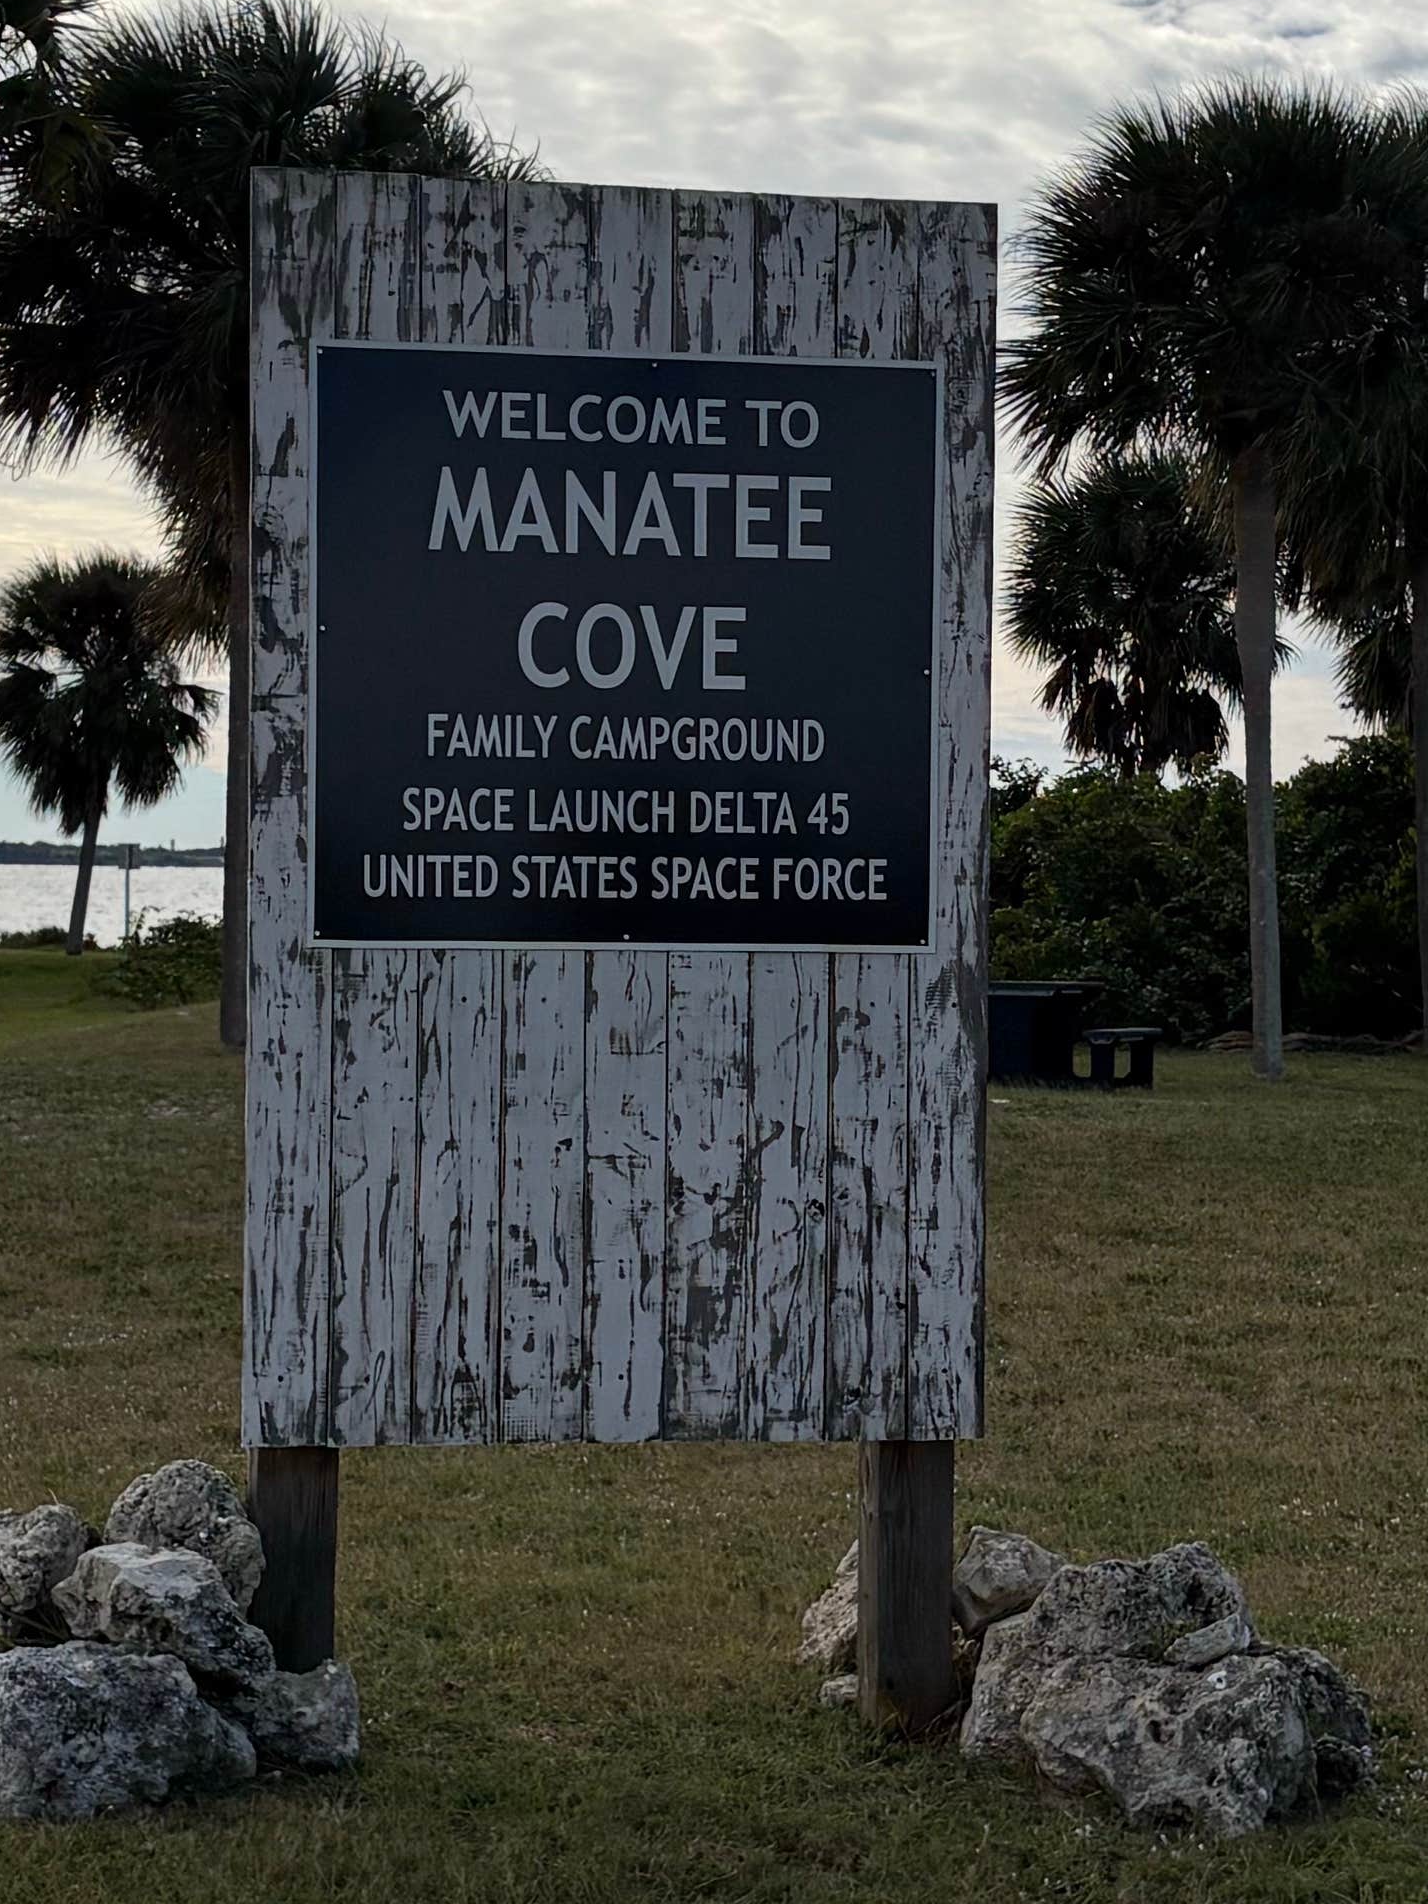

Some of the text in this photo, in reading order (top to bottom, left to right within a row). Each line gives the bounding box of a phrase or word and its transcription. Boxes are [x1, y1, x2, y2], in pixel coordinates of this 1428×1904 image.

[442, 389, 820, 449] WELCOME TO
[428, 465, 832, 560] MANATEE
[517, 601, 747, 691] COVE
[427, 713, 825, 763] FAMILY CAMPGROUND
[402, 787, 850, 835] SPACE LAUNCH DELTA 45
[363, 854, 888, 901] UNITED STATES SPACE FORCE
